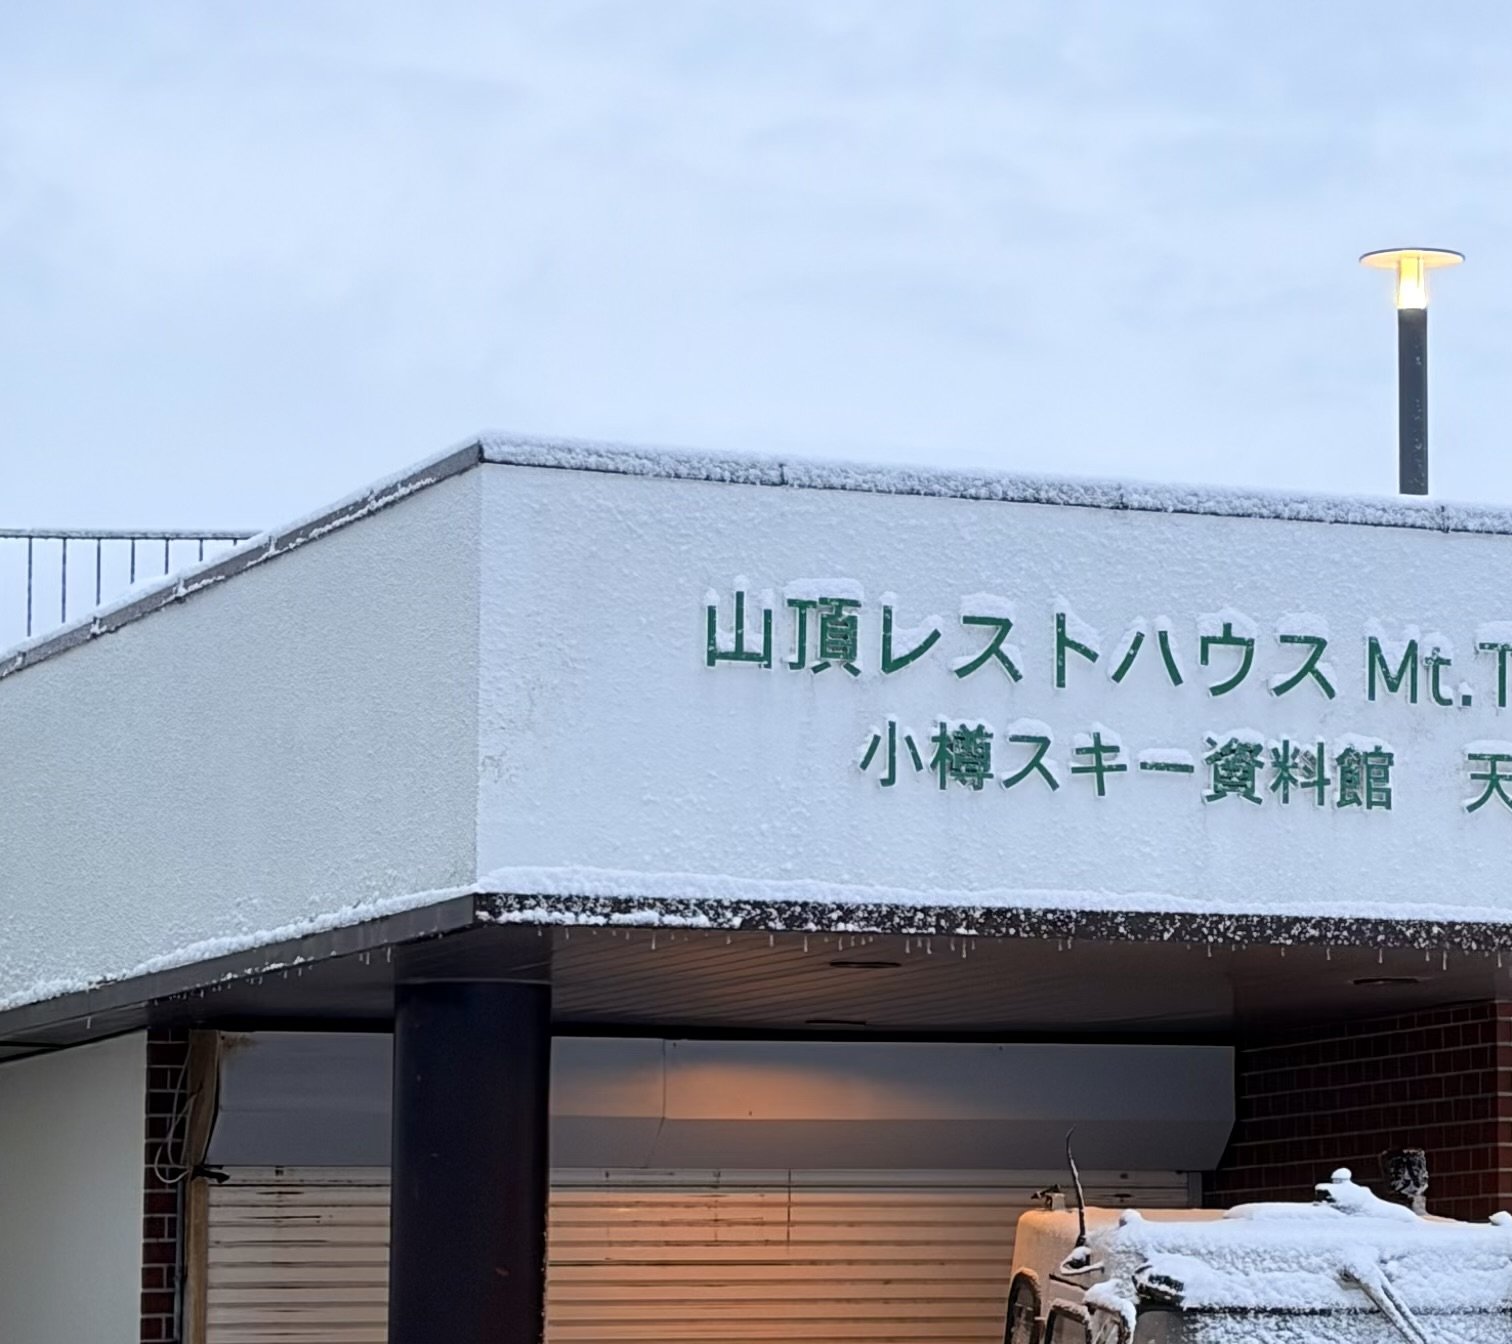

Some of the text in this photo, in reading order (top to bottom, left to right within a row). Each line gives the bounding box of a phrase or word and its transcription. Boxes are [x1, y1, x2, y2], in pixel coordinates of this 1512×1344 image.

[706, 590, 1336, 700] 山頂レストハウス
[858, 719, 1395, 810] 小樽スキー資料館
